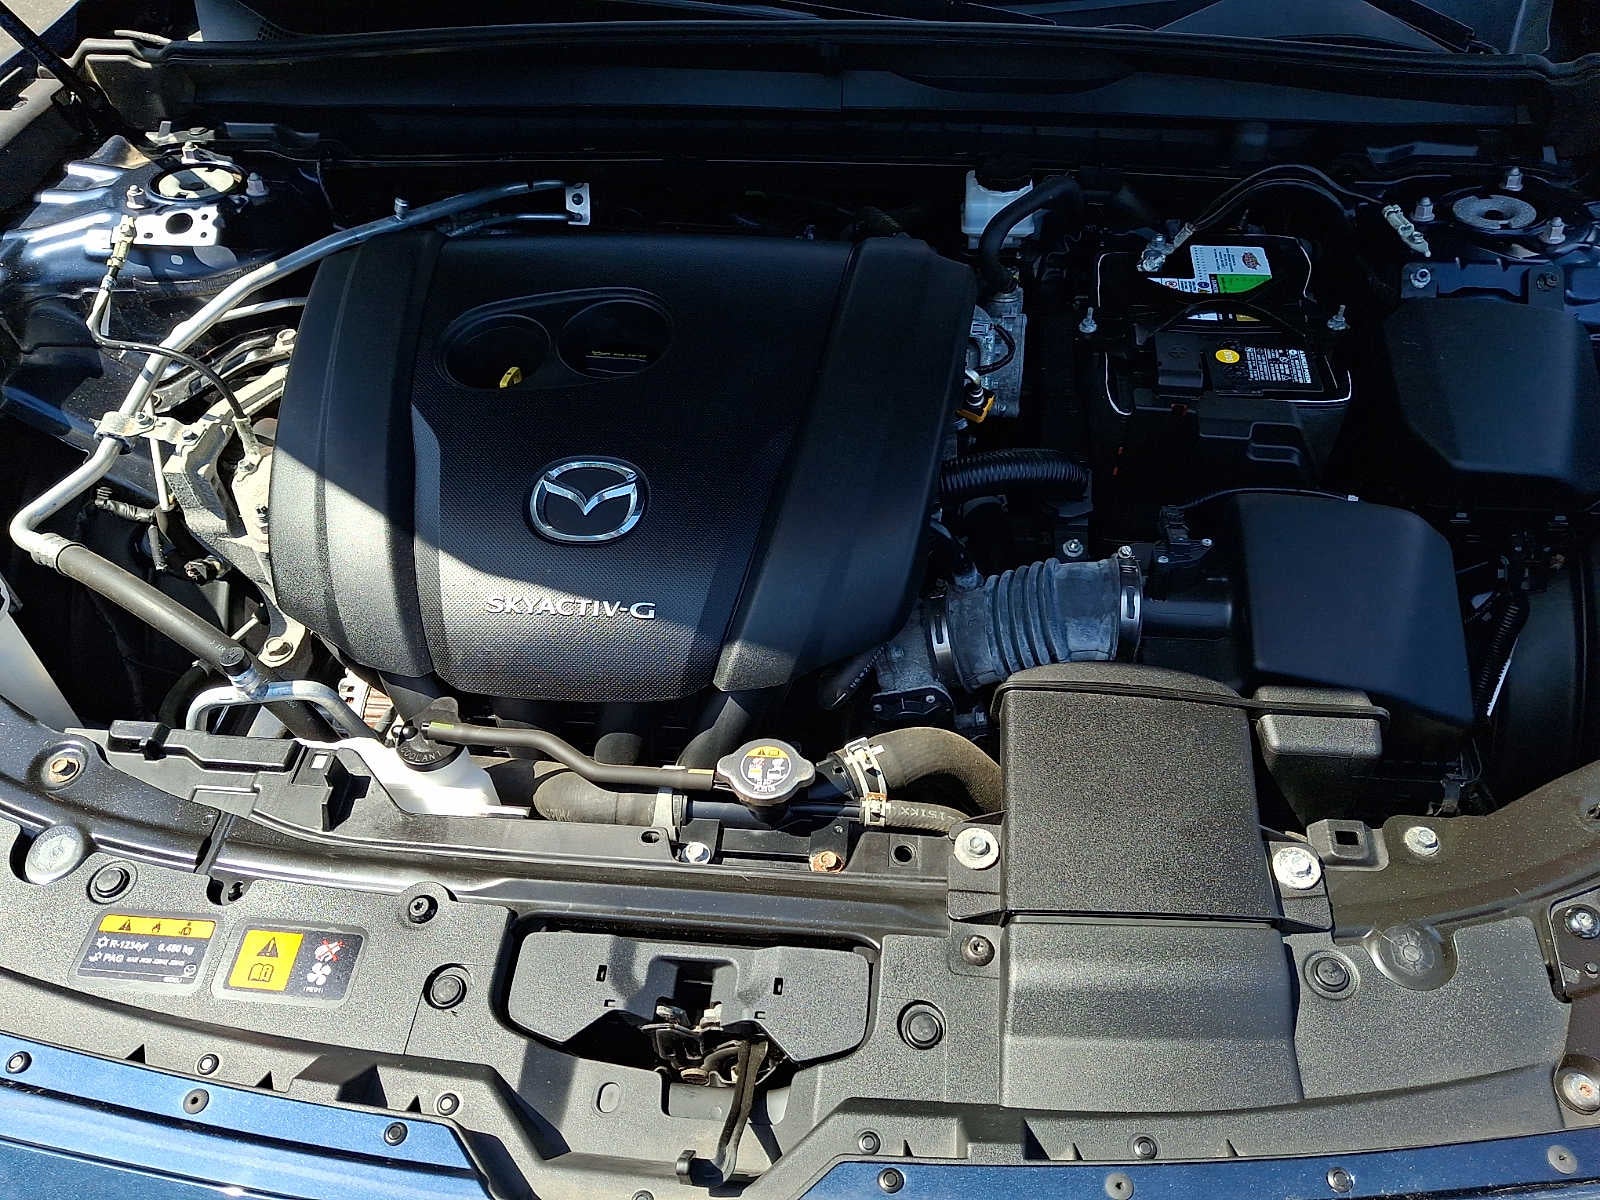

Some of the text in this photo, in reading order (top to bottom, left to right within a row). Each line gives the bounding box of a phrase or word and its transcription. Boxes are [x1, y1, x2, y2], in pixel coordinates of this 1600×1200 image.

[487, 597, 656, 620] SKYACTIV-G
[400, 746, 442, 762] COOLANT
[110, 939, 150, 952] R-1234yf
[182, 944, 195, 956] kg
[103, 953, 124, 963] PAG
